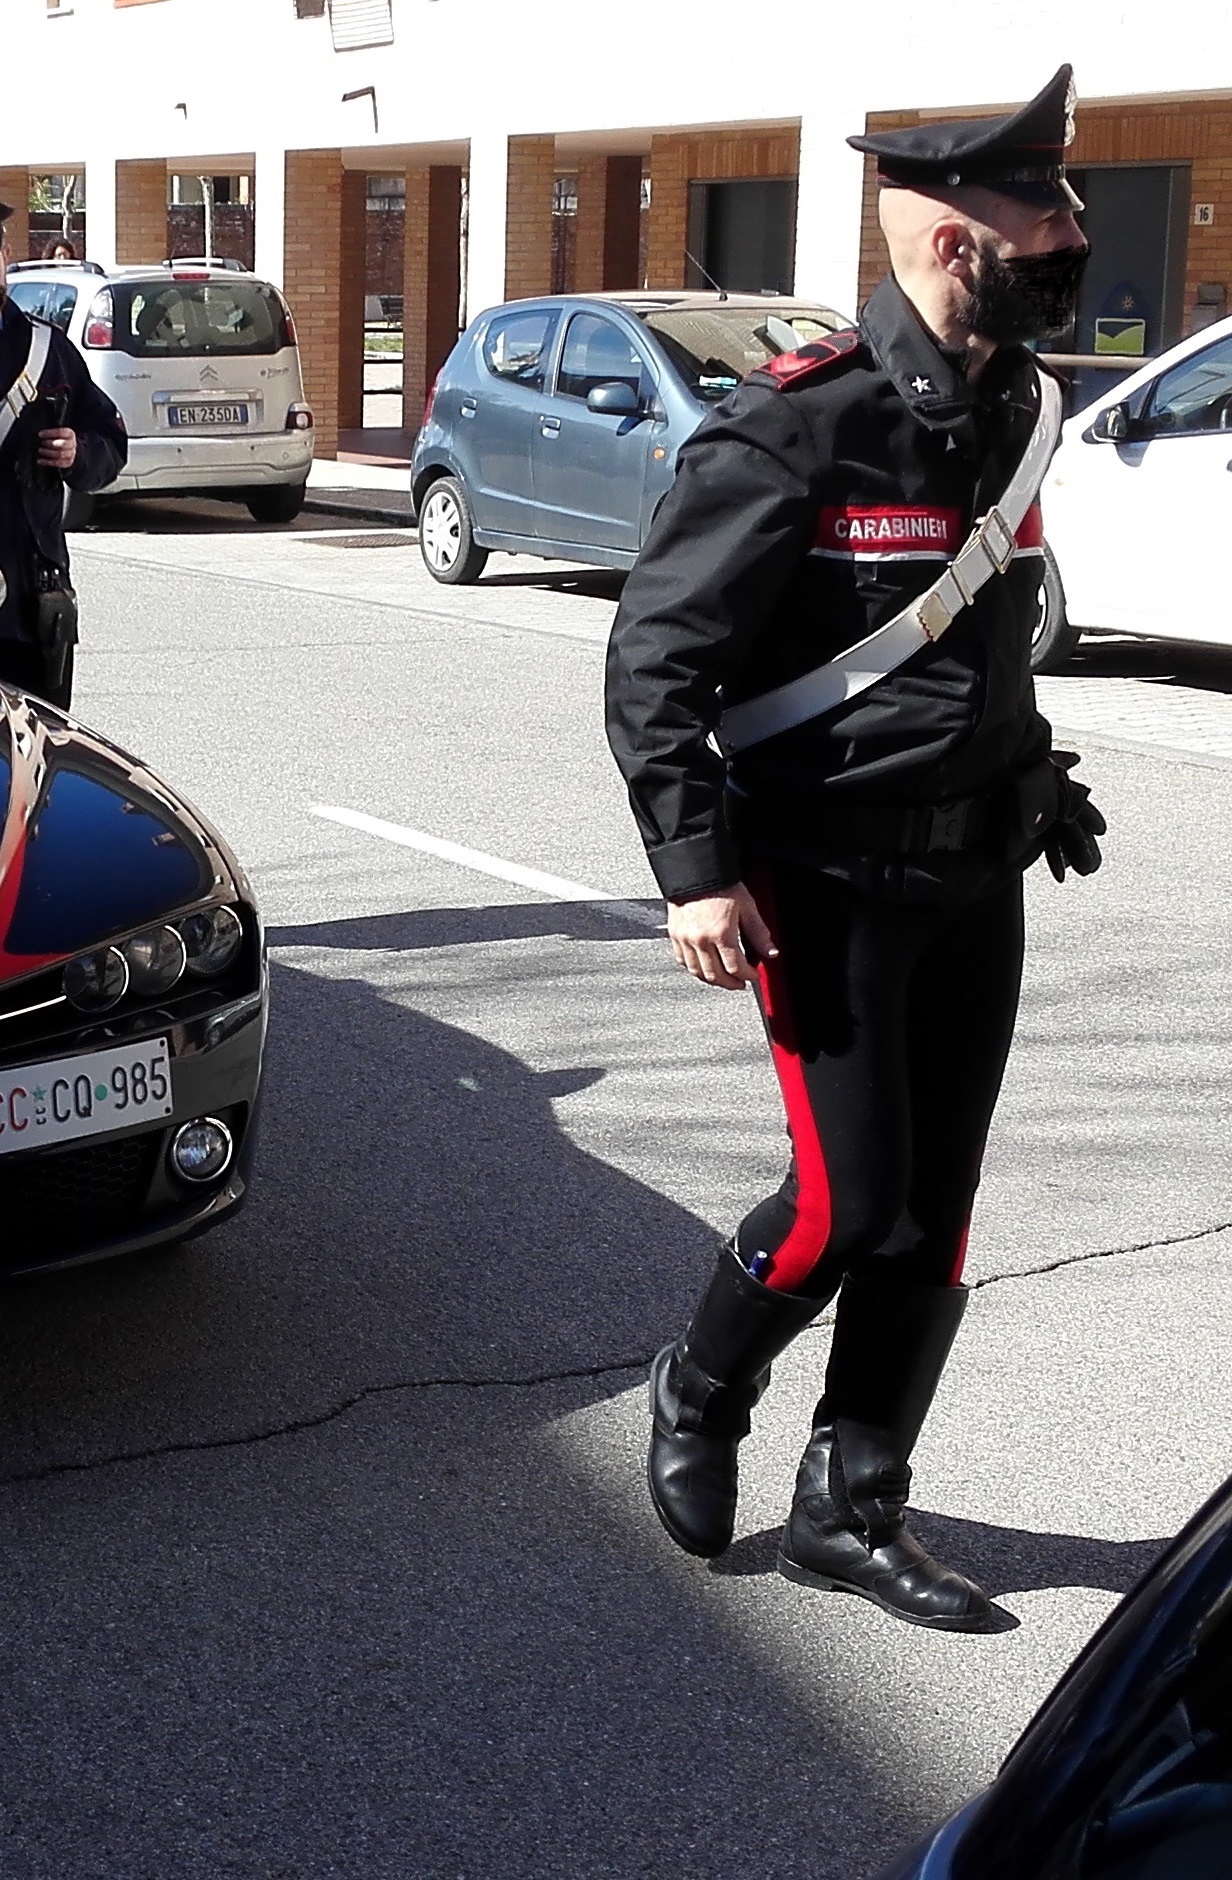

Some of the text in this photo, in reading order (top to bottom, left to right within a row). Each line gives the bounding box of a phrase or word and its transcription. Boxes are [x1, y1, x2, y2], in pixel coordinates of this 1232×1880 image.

[1199, 207, 1209, 222] 16
[179, 407, 239, 424] EN 235DA
[834, 517, 947, 539] CARABINIERI
[52, 1078, 92, 1123] CQ
[111, 1056, 167, 1110] 985
